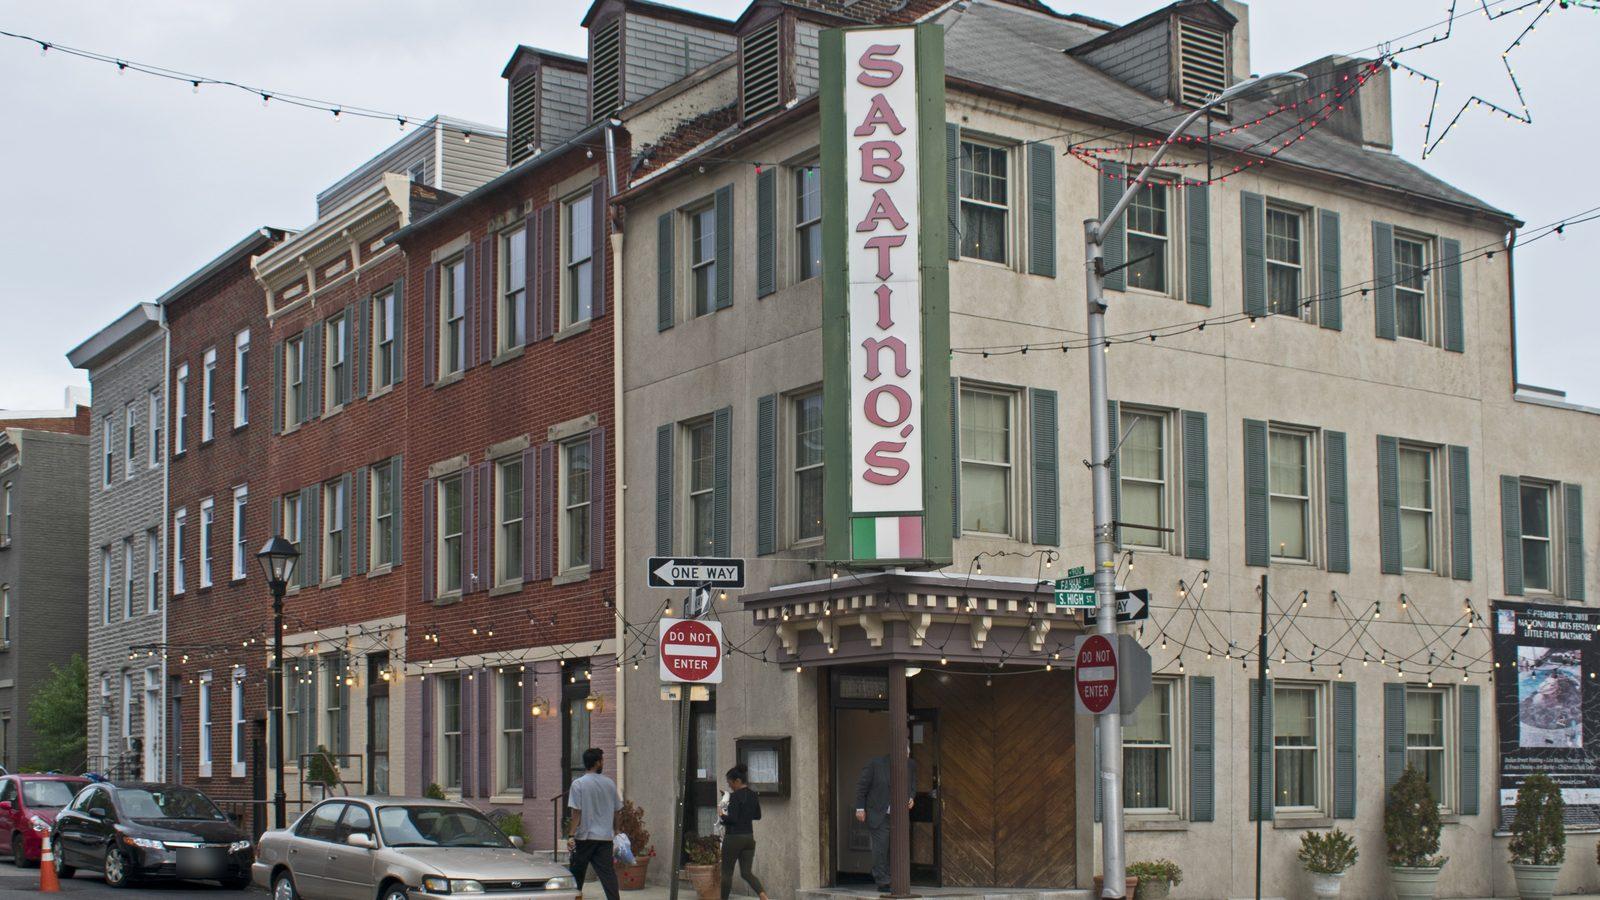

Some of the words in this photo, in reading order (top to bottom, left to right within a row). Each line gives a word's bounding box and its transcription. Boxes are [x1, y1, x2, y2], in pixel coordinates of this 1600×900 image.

[671, 567, 699, 579] ONE
[707, 567, 736, 580] WAY
[1059, 593, 1066, 605] S.
[1067, 593, 1084, 605] HIGH
[1558, 621, 1572, 630] ARTS
[1572, 622, 1598, 632] FESTIVAL
[669, 631, 685, 642] DO
[689, 632, 712, 643] NOT
[1524, 629, 1543, 638] LITTLE
[1544, 630, 1559, 639] ITALY
[1560, 631, 1592, 641] BALTIMORE
[1082, 651, 1092, 663] DO
[1095, 649, 1111, 662] NOT
[674, 658, 708, 670] ENTER
[1084, 685, 1109, 698] ENTER
